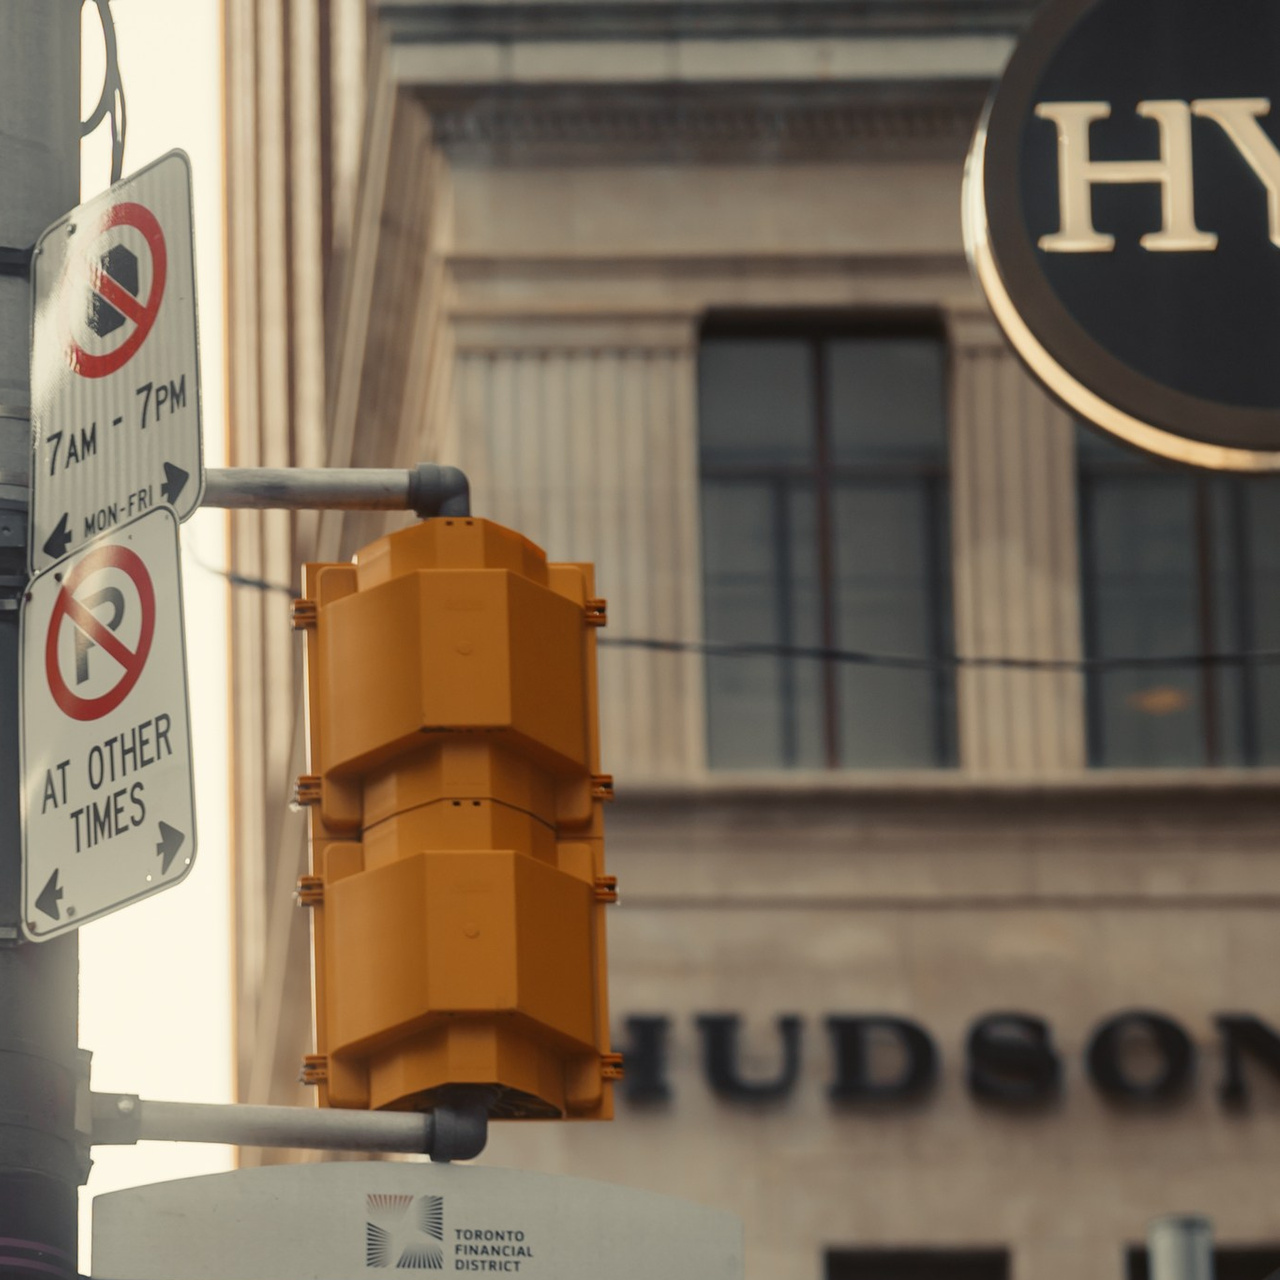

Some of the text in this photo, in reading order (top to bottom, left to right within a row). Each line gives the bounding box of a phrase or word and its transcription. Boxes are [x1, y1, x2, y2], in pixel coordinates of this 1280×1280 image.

[46, 422, 96, 476] 7AM
[136, 375, 186, 429] 7PM
[84, 484, 153, 538] MON-FRI
[41, 713, 173, 815] AT OTHER
[70, 781, 147, 854] TIMES
[454, 1228, 525, 1242] TORONTO
[455, 1244, 533, 1257] FINANCIAL
[455, 1259, 521, 1272] DISTRICT
